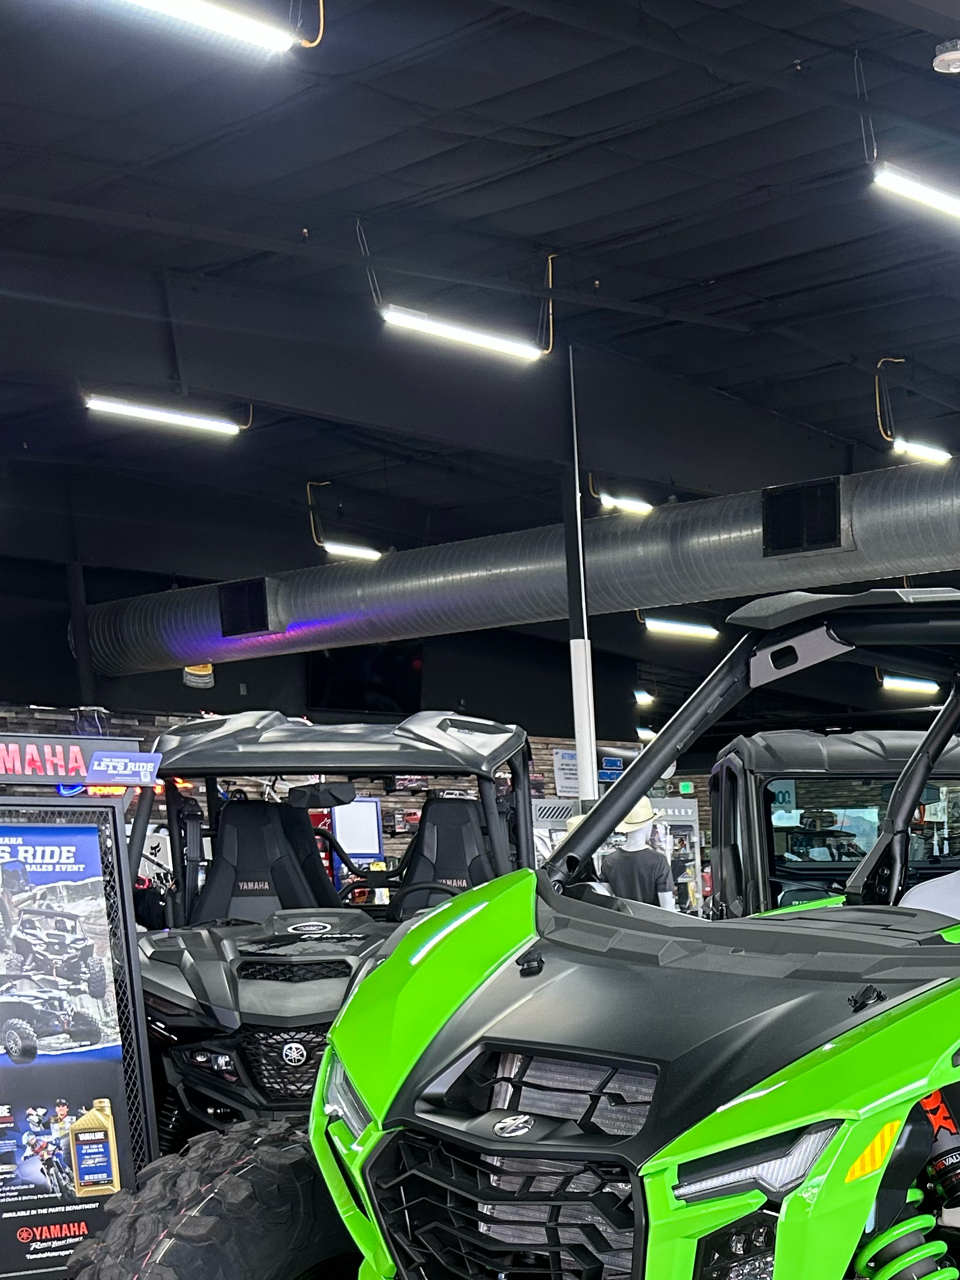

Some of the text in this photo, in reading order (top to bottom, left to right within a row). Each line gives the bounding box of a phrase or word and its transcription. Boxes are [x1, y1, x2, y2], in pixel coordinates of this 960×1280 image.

[0, 743, 88, 777] MAHA
[93, 761, 155, 772] LET'S RIDE
[653, 808, 693, 816] OKLEY
[17, 845, 76, 863] RIDE
[25, 864, 85, 872] SALES EVENT
[238, 881, 270, 890] YAMAHA
[920, 1088, 960, 1143] OX
[2, 1210, 30, 1218] AVAILABLE
[65, 1202, 100, 1212] DEPARTMENT
[33, 1221, 88, 1240] YAMAHA
